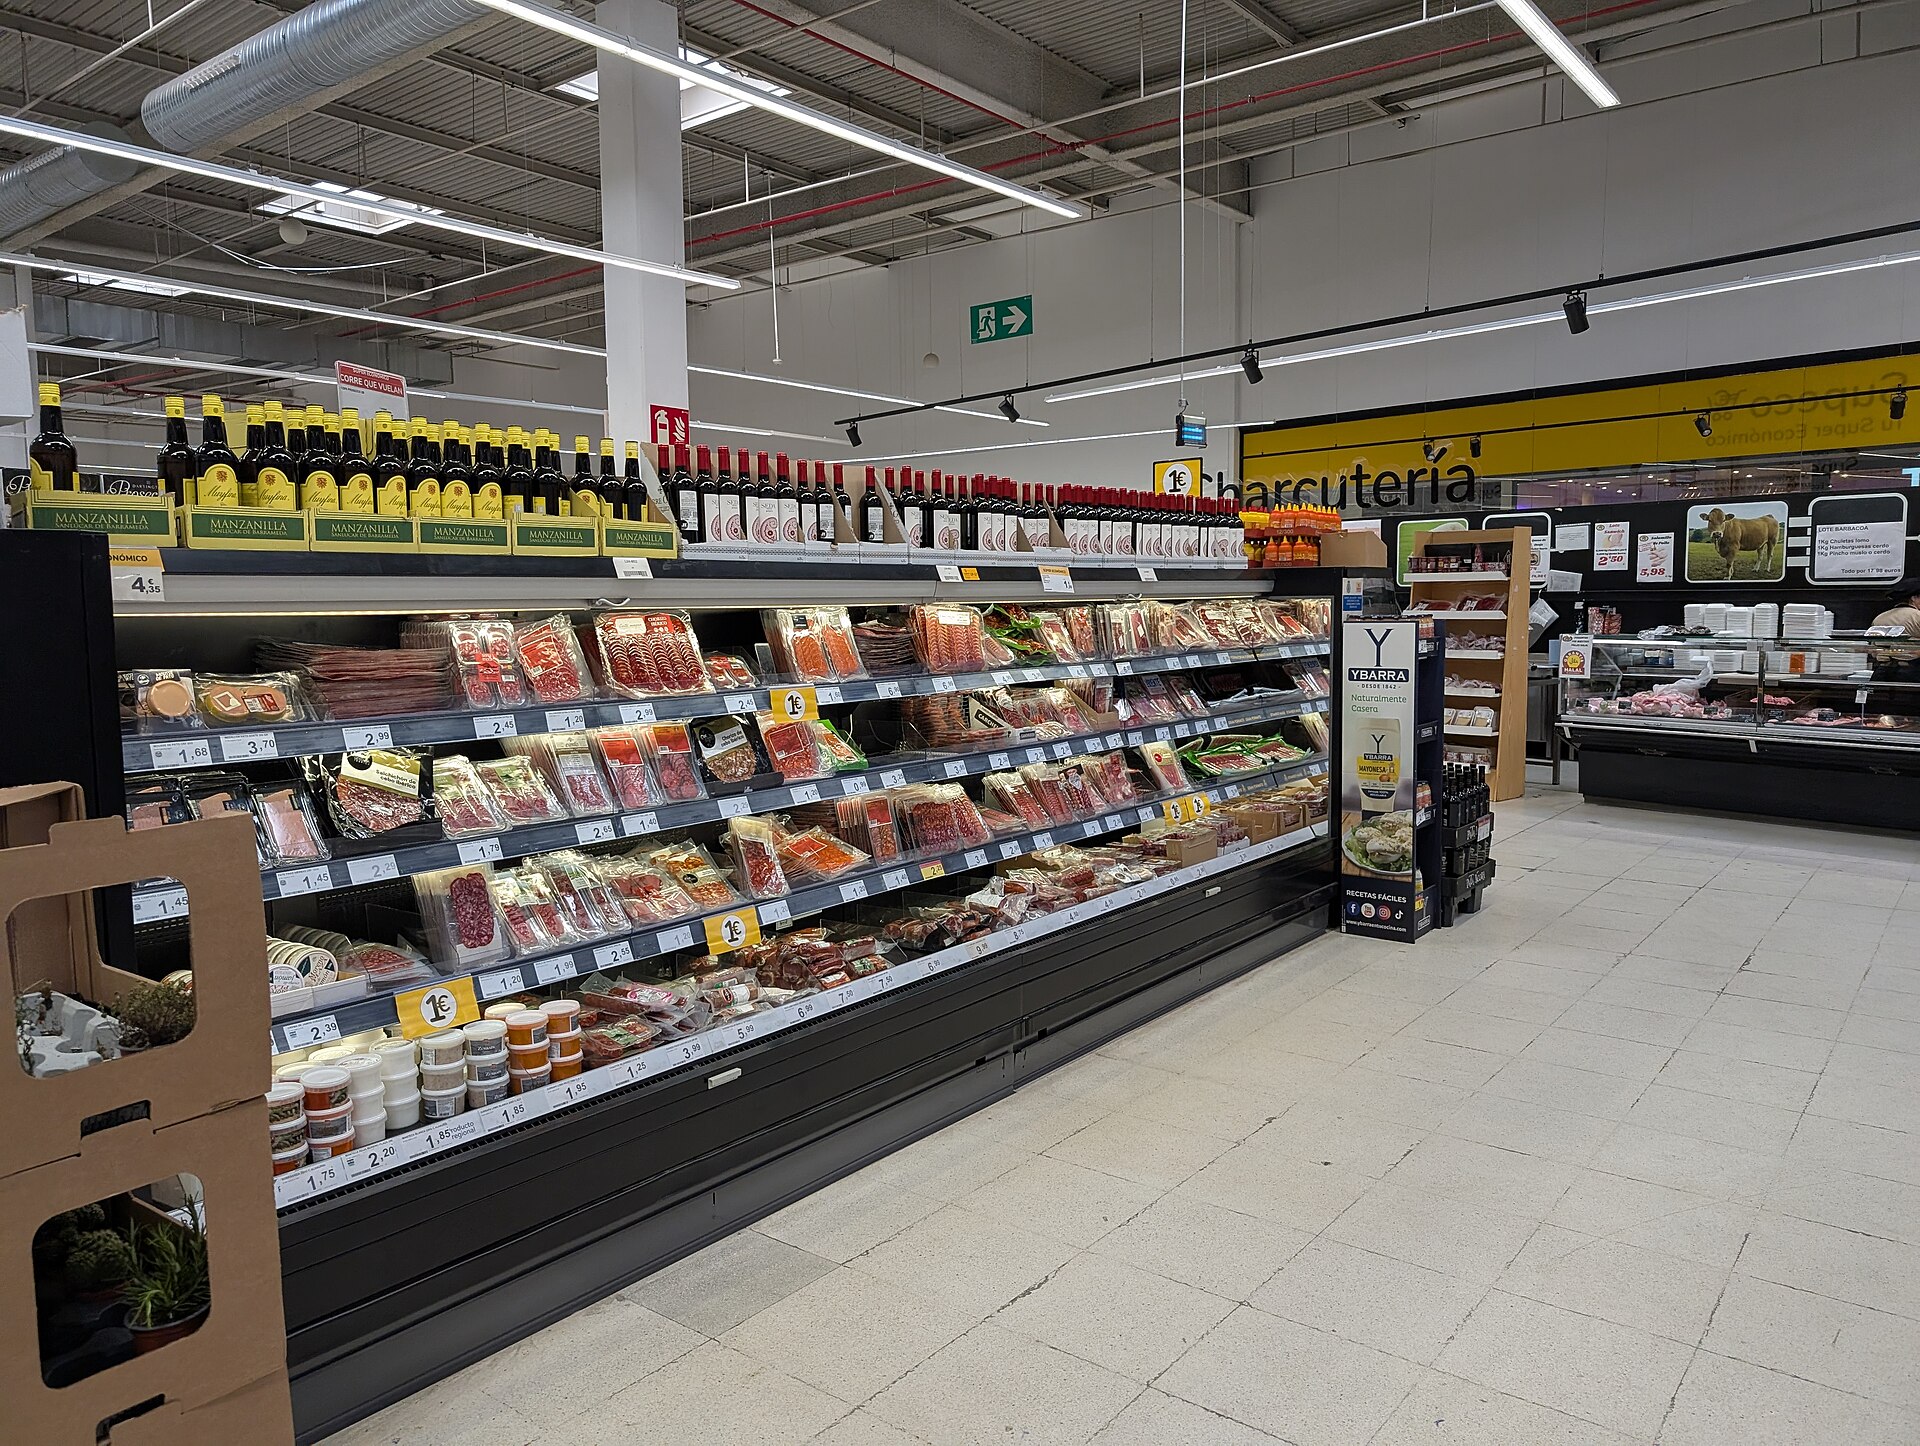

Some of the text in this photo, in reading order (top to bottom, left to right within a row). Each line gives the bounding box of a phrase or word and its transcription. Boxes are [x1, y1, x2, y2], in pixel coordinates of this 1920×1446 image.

[340, 374, 362, 386] CORRE
[363, 379, 377, 390] QUE
[378, 382, 403, 395] VUELAN
[1168, 470, 1187, 493] 1€
[55, 513, 148, 525] MANZANILLA
[210, 519, 287, 531] MANZANILLA
[331, 523, 398, 534] MANZANILLA
[434, 527, 494, 537] MANZANILLA
[529, 530, 583, 540] MANZANILLA
[616, 532, 662, 542] MANZANILLA
[1640, 568, 1666, 577] 5,98
[1364, 628, 1394, 667] Y
[1351, 669, 1406, 681] YBARRA
[787, 694, 802, 715] 1€
[1351, 694, 1407, 704] Naturalmente
[1351, 704, 1378, 713] Casera
[493, 720, 514, 734] 2,45
[564, 715, 584, 728] 1,20
[365, 731, 390, 746] 2,99
[248, 739, 275, 754] 3,70
[179, 747, 208, 763] 1,68
[1359, 765, 1387, 773] MAYONESA
[593, 825, 612, 838] 2,65
[479, 844, 500, 858] 1,79
[371, 862, 395, 877] 2,29
[303, 873, 329, 889] 1,45
[1346, 889, 1407, 904] RECETAS FÁCILES
[158, 896, 188, 914] 1,45
[724, 920, 742, 942] 1€
[674, 932, 691, 946] 1,20
[611, 947, 630, 962] 2,55
[554, 961, 574, 976] 1,99
[501, 975, 522, 990] 1,20
[879, 975, 893, 989] 7,50
[838, 989, 854, 1003] 7,50
[426, 994, 451, 1023] 1€
[797, 1004, 814, 1019] 6,99
[311, 1022, 337, 1040] 2,39
[738, 1024, 754, 1039] 5,99
[682, 1043, 701, 1059] 3,99
[627, 1061, 647, 1078] 1,25
[565, 1083, 587, 1100] 1,95
[502, 1104, 525, 1122] 1,85
[425, 1129, 451, 1149] 1,85
[451, 1127, 476, 1140] regional
[368, 1146, 395, 1168] 2,20
[307, 1168, 336, 1190] 1,75
